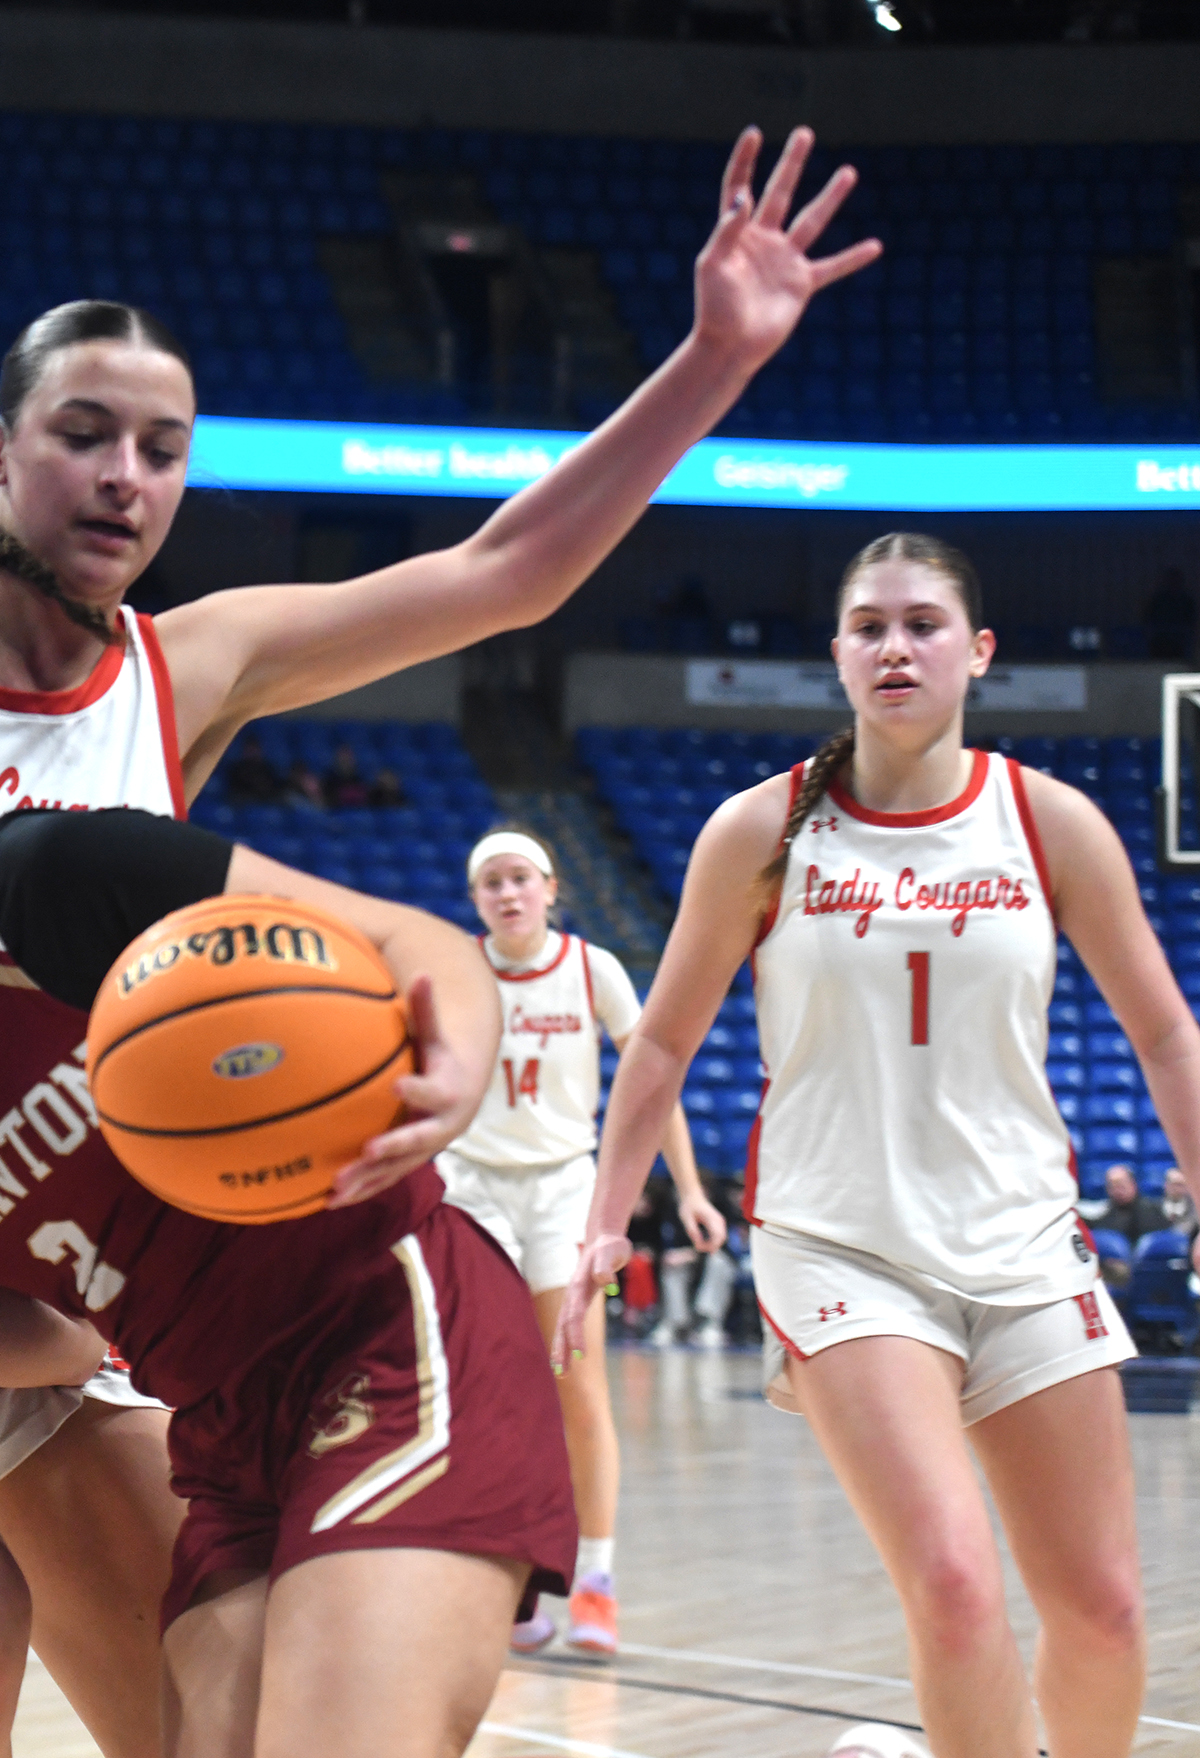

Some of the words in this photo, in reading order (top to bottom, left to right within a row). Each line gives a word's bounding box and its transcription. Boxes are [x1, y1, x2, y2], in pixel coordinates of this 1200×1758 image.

[341, 439, 443, 477] Better
[449, 442, 552, 479] health
[714, 455, 850, 498] Geisinger
[803, 864, 883, 939] Lady
[895, 867, 1029, 937] Cougars
[116, 922, 340, 1000] Wilson
[509, 1003, 582, 1049] Cougars
[906, 951, 930, 1045] 1
[501, 1056, 540, 1108] 14
[26, 1219, 127, 1313] 2
